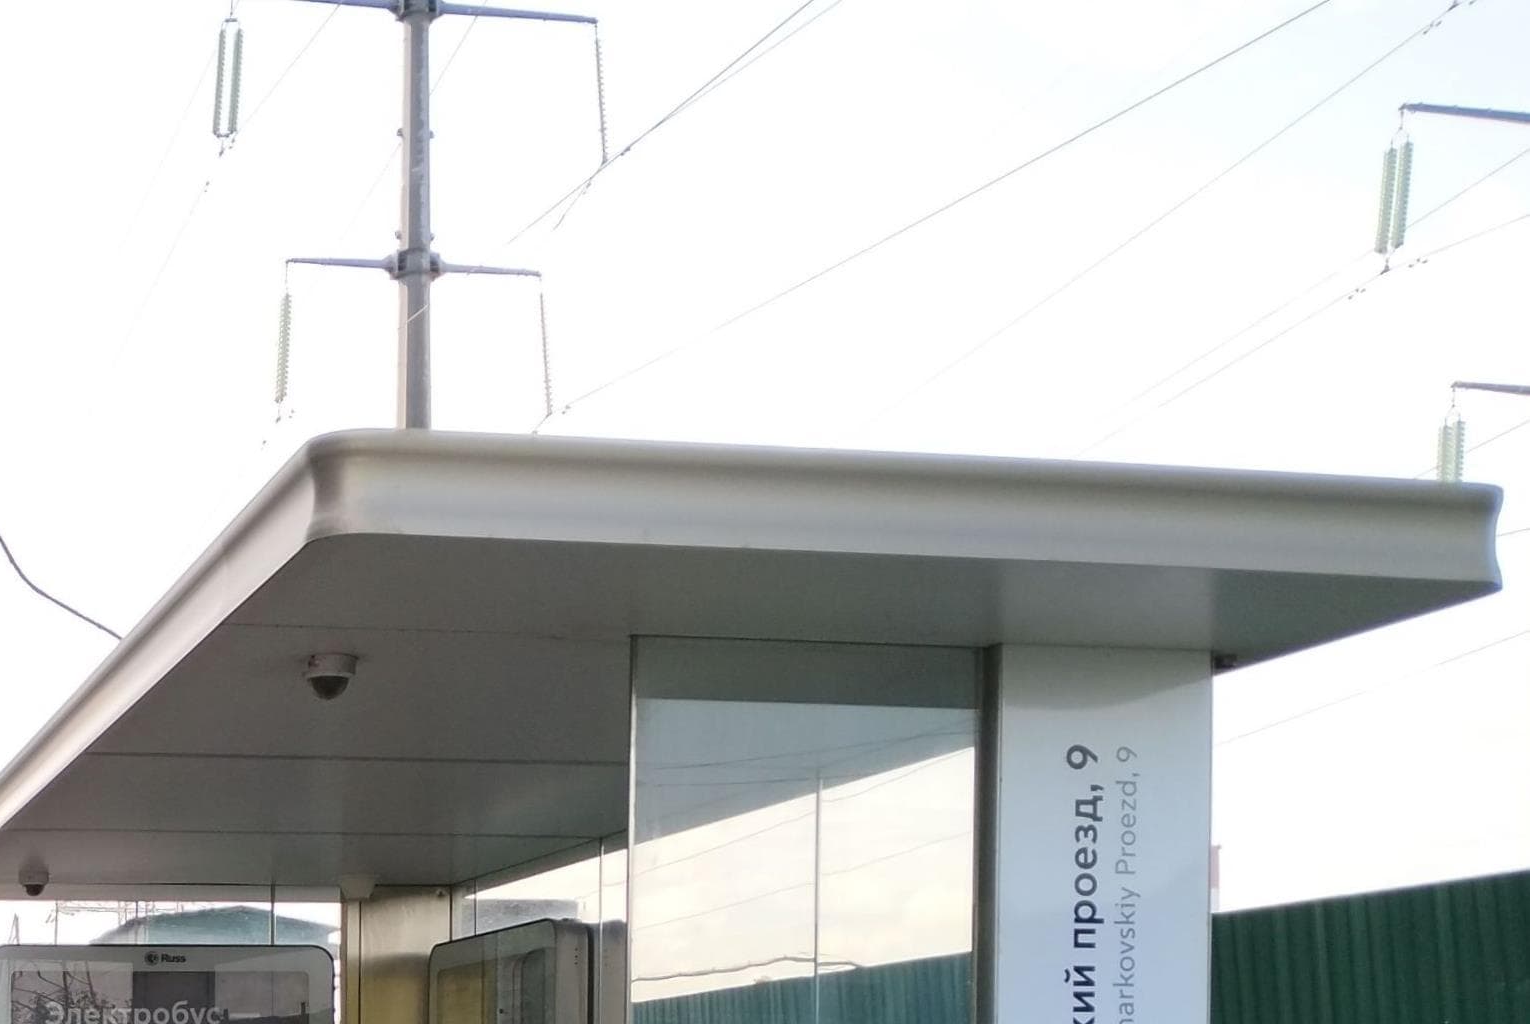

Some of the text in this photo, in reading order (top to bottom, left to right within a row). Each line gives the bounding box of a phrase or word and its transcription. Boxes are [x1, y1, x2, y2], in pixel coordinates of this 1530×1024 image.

[1066, 743, 1099, 770] 9
[1116, 745, 1138, 763] 9
[1114, 771, 1141, 875] Proezd,
[1072, 784, 1104, 949] проезд,
[160, 953, 187, 964] Russ
